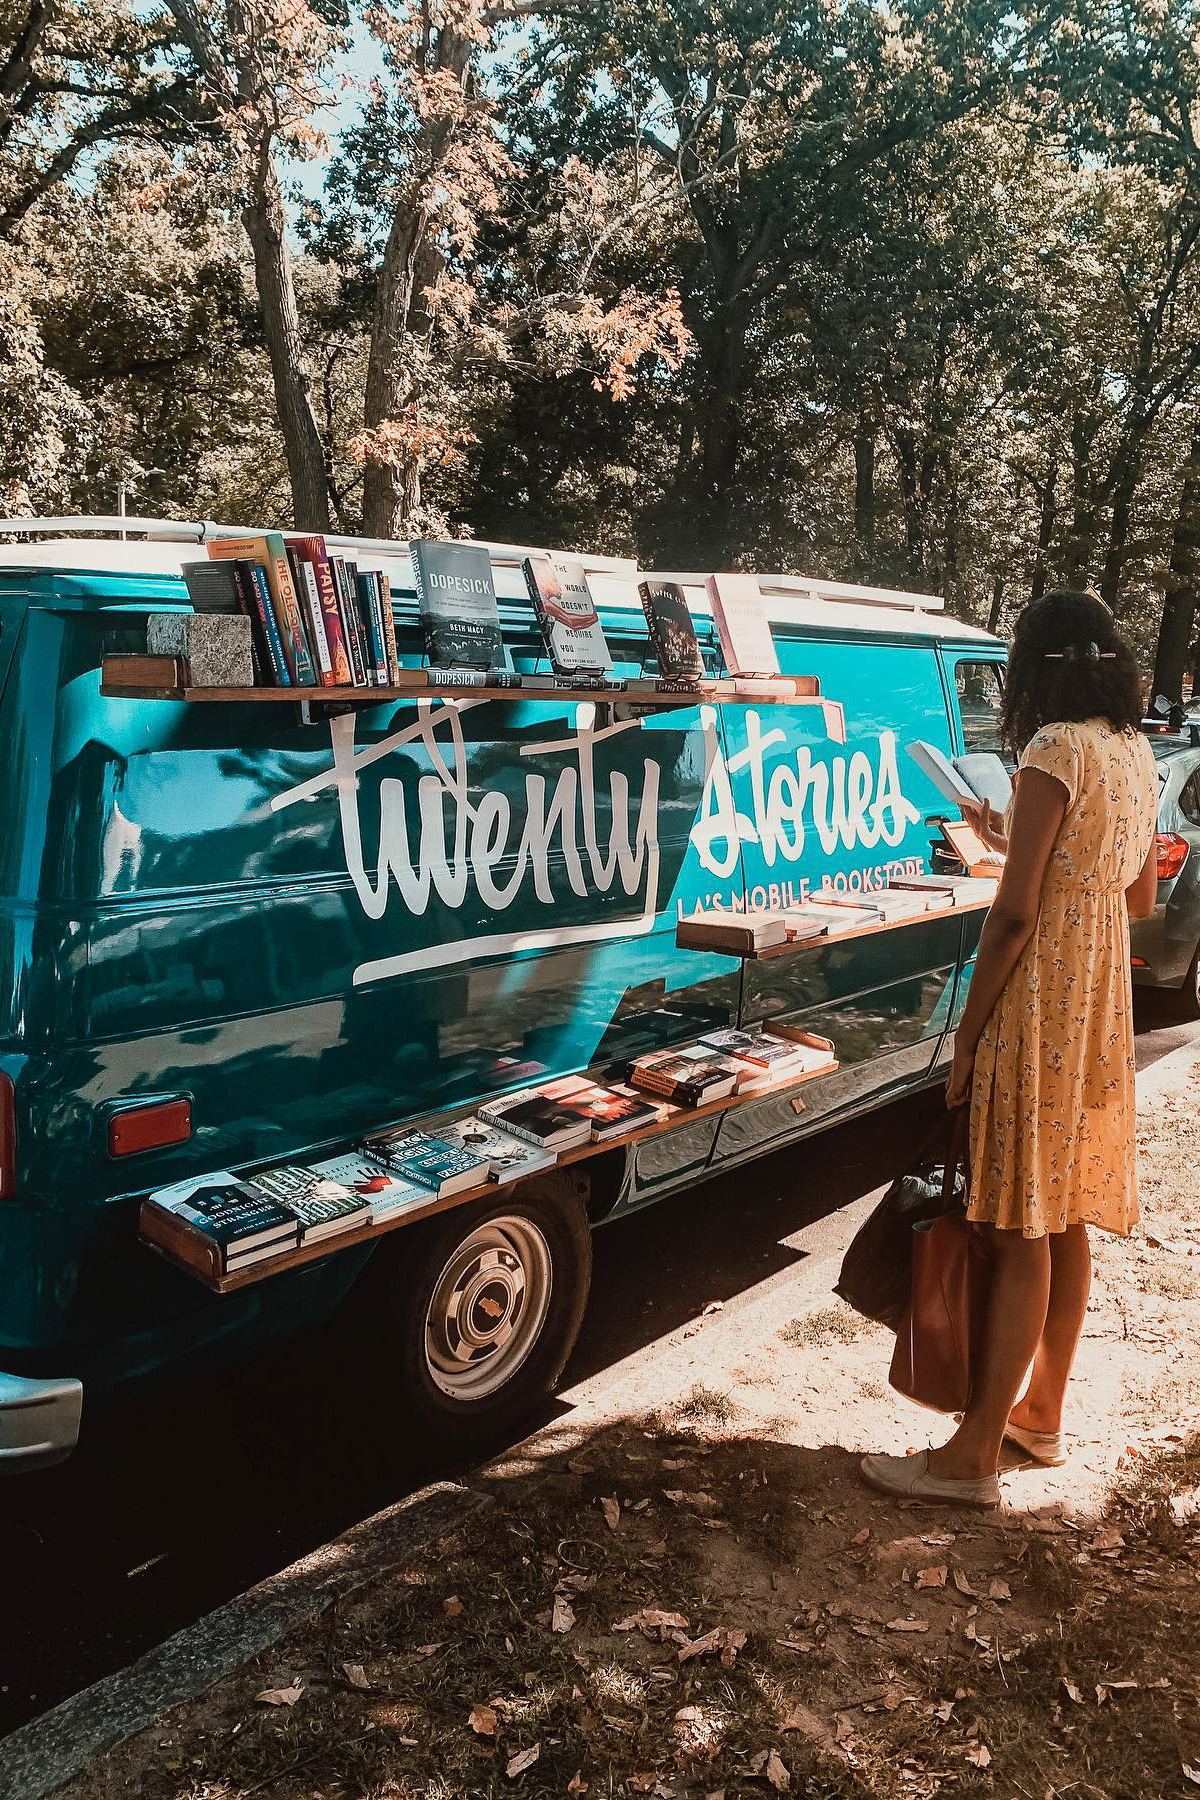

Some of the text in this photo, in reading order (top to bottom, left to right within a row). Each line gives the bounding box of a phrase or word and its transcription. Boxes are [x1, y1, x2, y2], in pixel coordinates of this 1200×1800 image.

[276, 559, 289, 582] THE
[410, 549, 425, 602] DOPESICK
[554, 564, 568, 573] THE
[317, 563, 339, 615] PATSY
[429, 573, 491, 595] DOPESICK
[564, 584, 587, 593] WORLD
[560, 601, 589, 611] DOESN'T
[449, 623, 485, 634] BETH MACY
[560, 644, 575, 653] YOU
[435, 672, 475, 685] DOPESICK
[731, 878, 811, 914] MOBILE
[821, 858, 925, 897] BOOKSTORE
[386, 1132, 431, 1151] BLACK
[389, 1144, 433, 1163] LIGHT
[249, 1166, 318, 1201] HARD
[198, 1197, 270, 1225] GOODNIGHT
[212, 1203, 276, 1229] STRANGER
